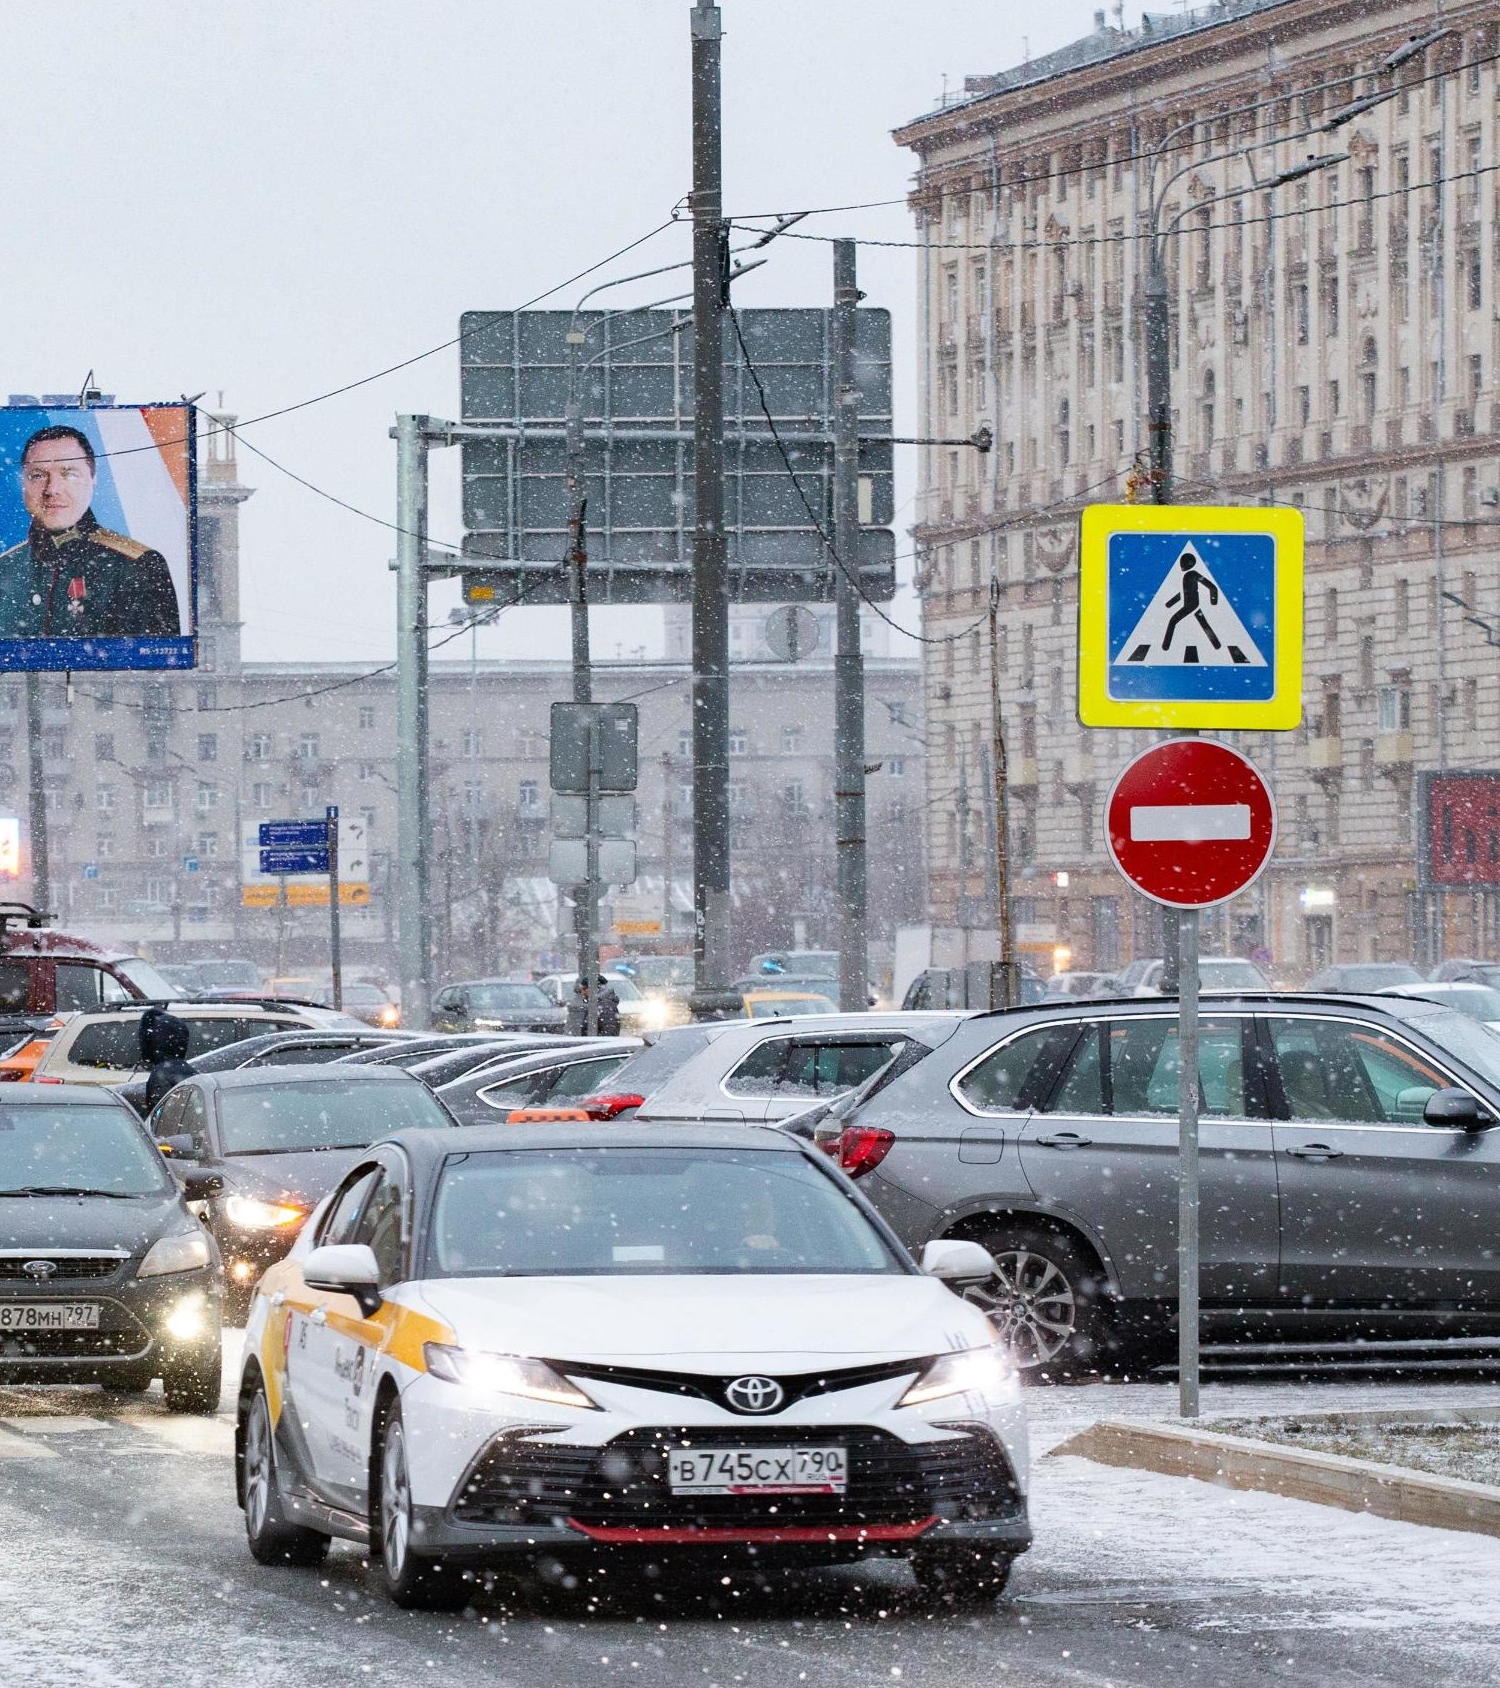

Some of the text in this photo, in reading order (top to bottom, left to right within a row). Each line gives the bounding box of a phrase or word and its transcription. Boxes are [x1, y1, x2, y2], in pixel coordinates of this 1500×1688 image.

[66, 1306, 93, 1321] 797
[680, 1452, 838, 1481] В745СХ 790
